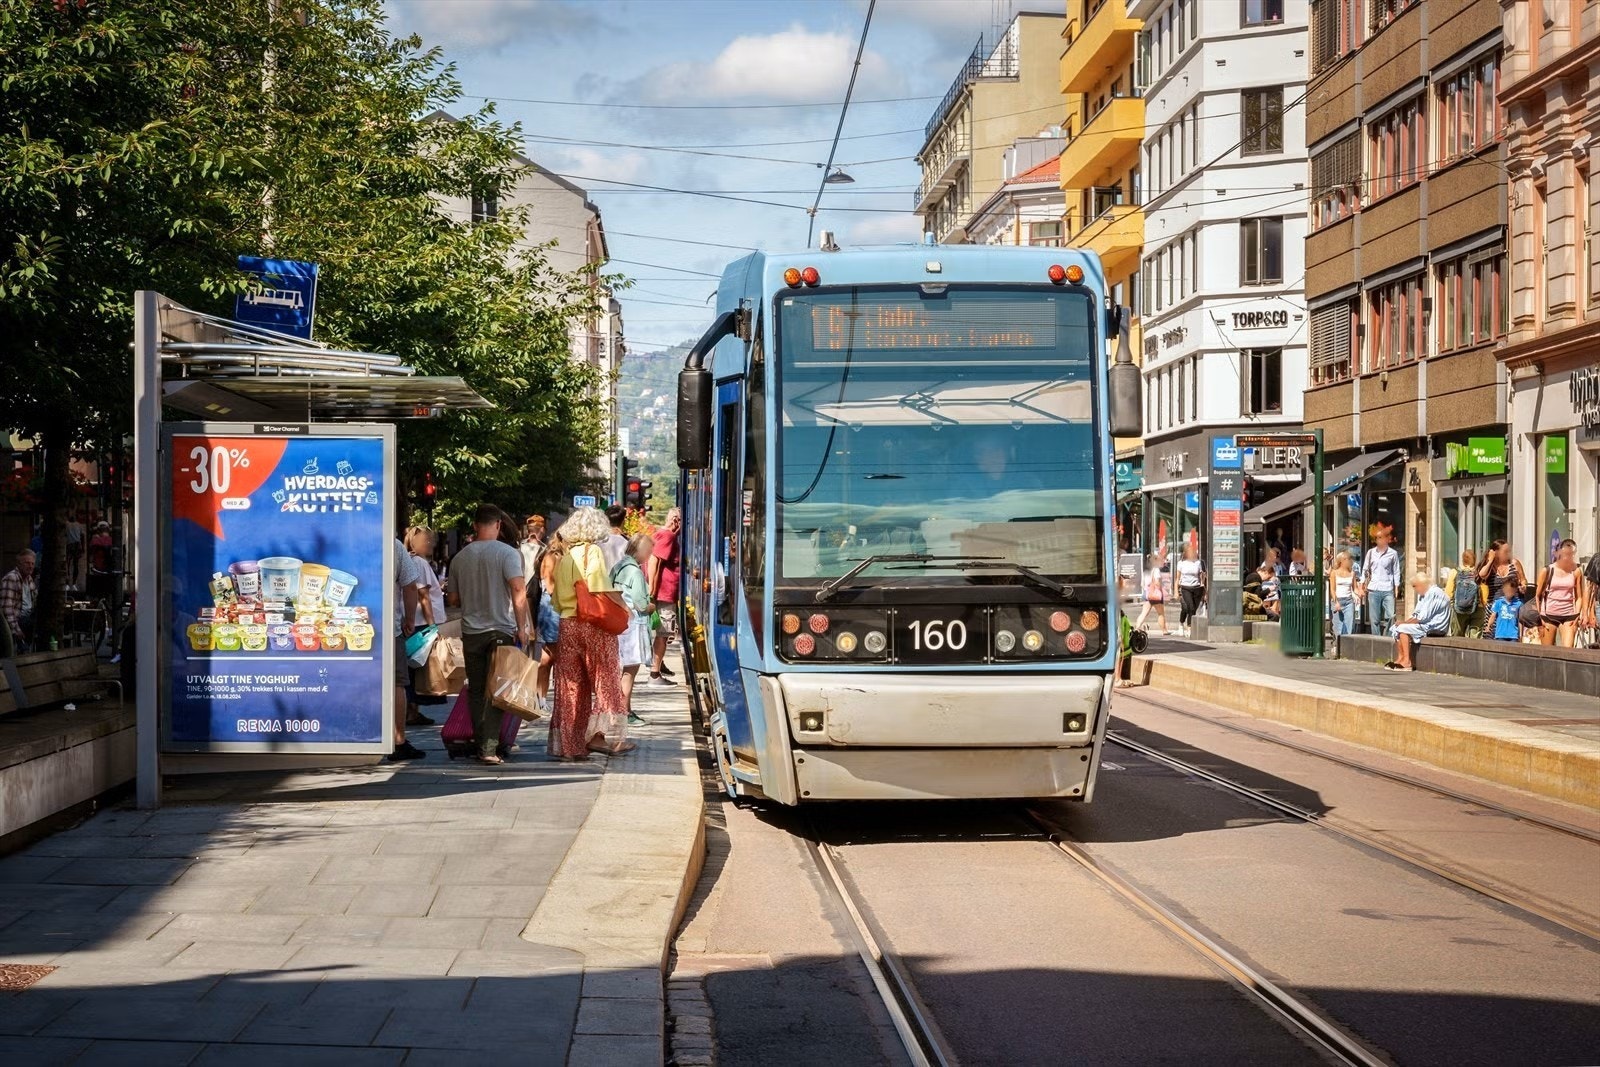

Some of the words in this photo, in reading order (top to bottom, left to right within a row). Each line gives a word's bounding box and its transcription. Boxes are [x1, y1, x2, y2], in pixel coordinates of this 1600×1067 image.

[1231, 310, 1288, 328] TORP&CO
[1477, 455, 1503, 464] Musti
[181, 446, 250, 494] -30%
[284, 475, 374, 491] HVERDAGS-
[288, 492, 366, 513] KUTTET
[908, 619, 967, 650] 160
[186, 675, 229, 684] UTVALGT
[231, 675, 252, 684] TINE
[254, 675, 300, 684] YOGHURT
[204, 685, 230, 693] 90-1000
[237, 685, 251, 693] 30%
[252, 685, 273, 693] trekkes
[274, 685, 283, 693] fra
[287, 685, 307, 693] kassen
[307, 685, 321, 693] med
[237, 719, 282, 732] REMA
[285, 719, 320, 732] 1000
